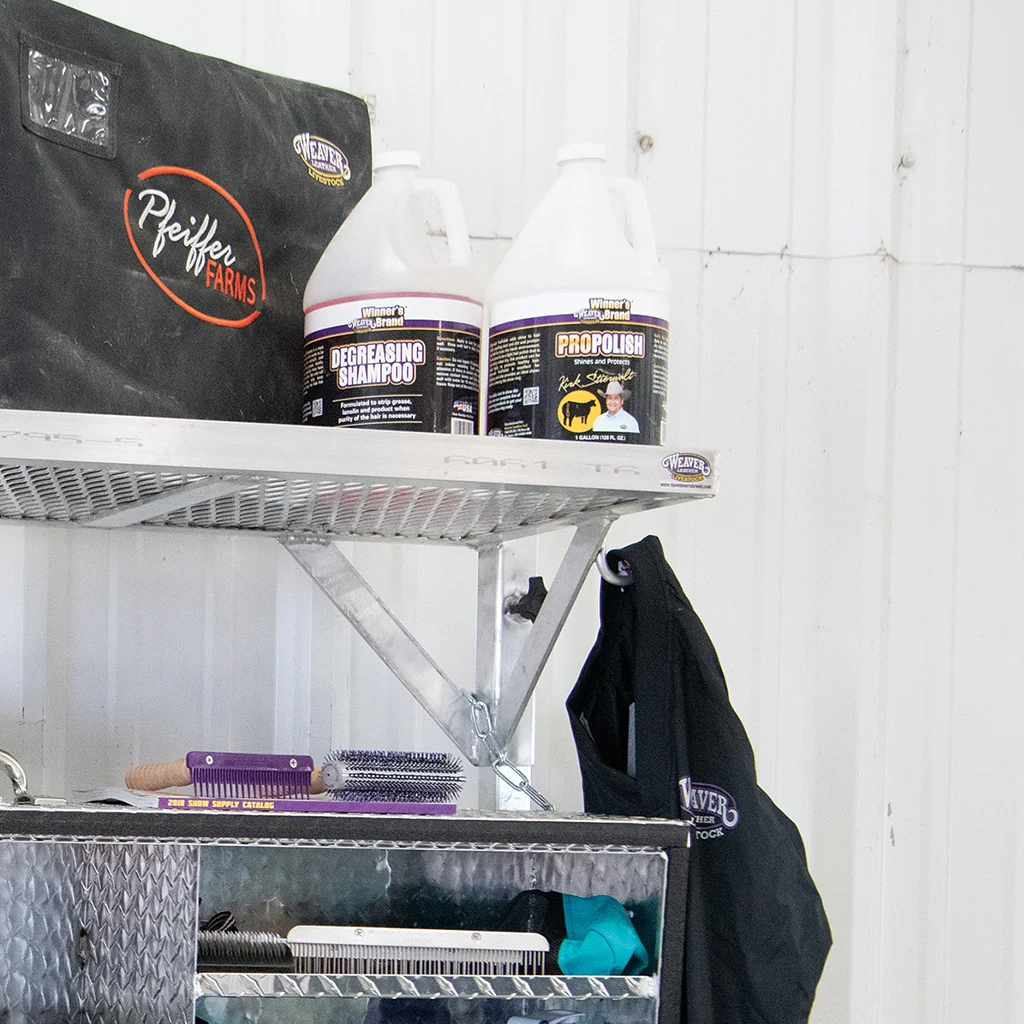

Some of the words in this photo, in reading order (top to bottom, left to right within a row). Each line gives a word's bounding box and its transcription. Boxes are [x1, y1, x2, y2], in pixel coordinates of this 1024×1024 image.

[292, 132, 352, 180] WEAVER
[308, 167, 345, 187] LIVESTOCK
[138, 189, 236, 277] Pfeiffer
[205, 259, 257, 306] FARMS
[361, 305, 405, 319] Winner's
[589, 298, 631, 310] Winner's
[375, 316, 405, 328] Brand
[604, 309, 631, 321] Brand
[557, 333, 643, 356] PROPOLISH
[331, 342, 423, 369] DEGREASING
[339, 362, 414, 387] SHAMPOO
[340, 400, 370, 409] Formulated
[378, 399, 391, 407] strip
[371, 405, 393, 414] product
[661, 453, 711, 477] WEAVER
[242, 801, 275, 809] CATALOG
